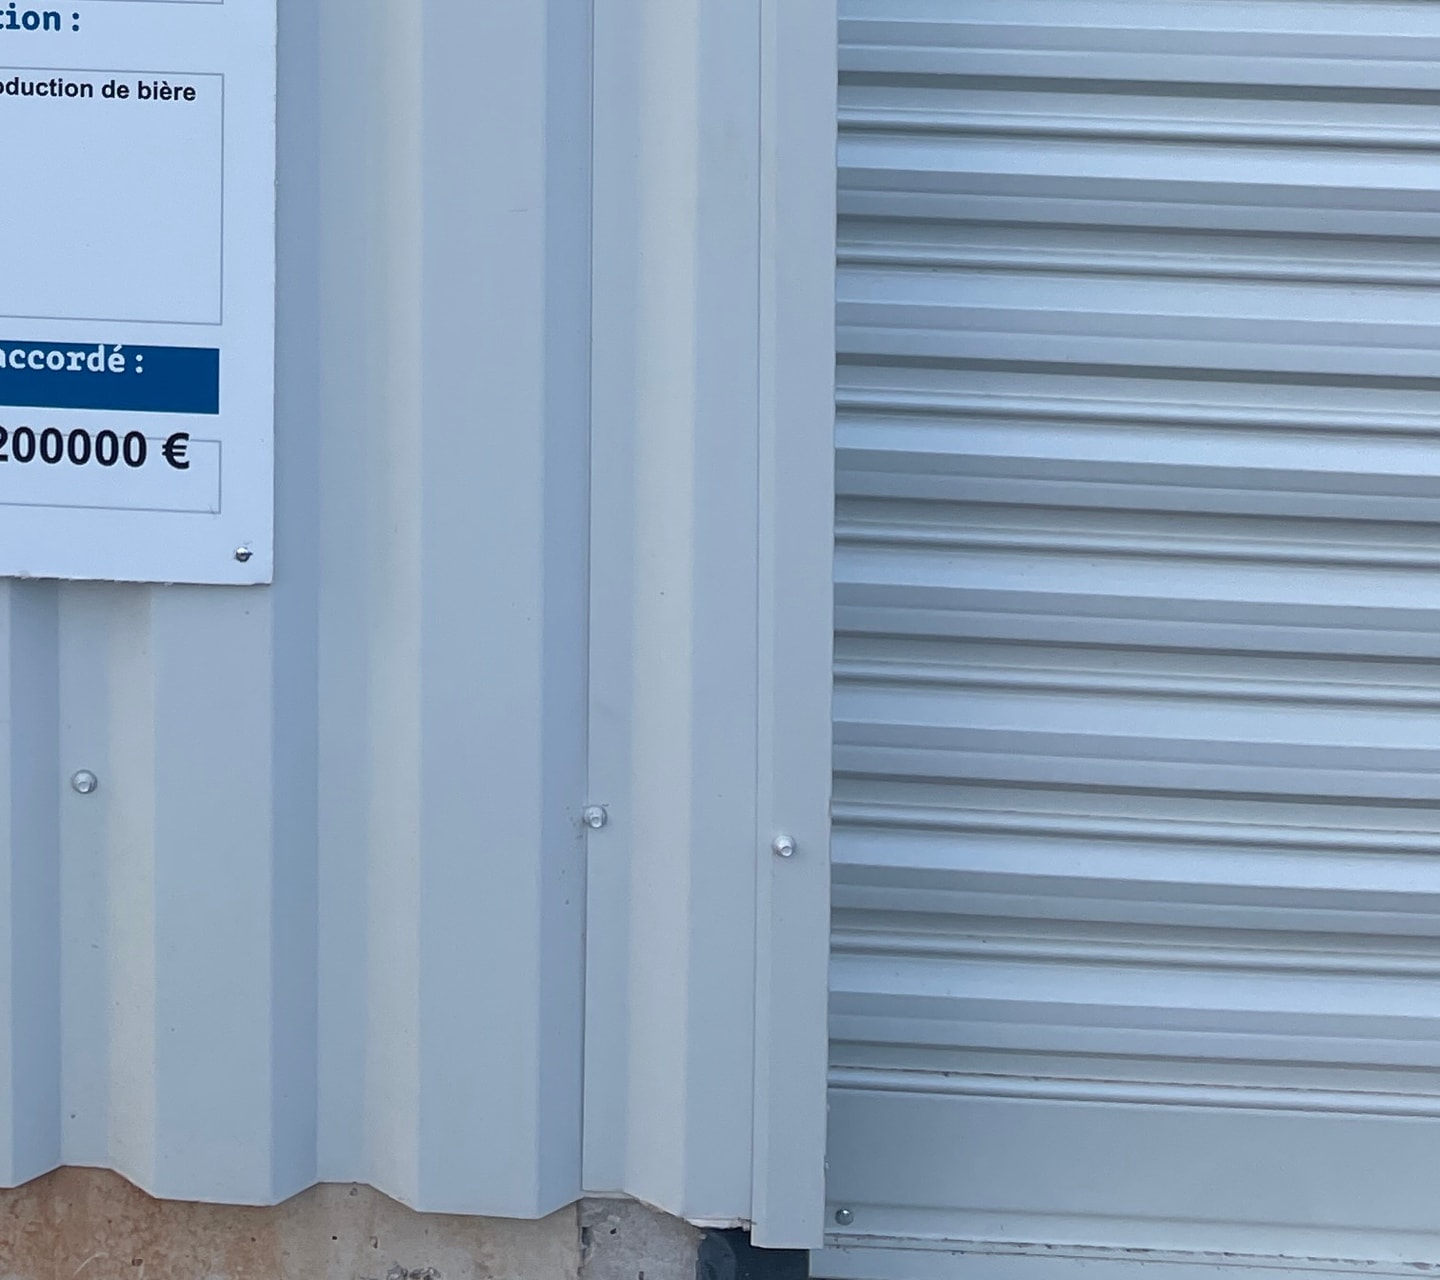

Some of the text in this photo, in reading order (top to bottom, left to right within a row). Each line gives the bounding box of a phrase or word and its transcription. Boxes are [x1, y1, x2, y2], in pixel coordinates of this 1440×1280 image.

[101, 79, 130, 100] de
[137, 80, 196, 102] bière
[161, 432, 191, 470] €
